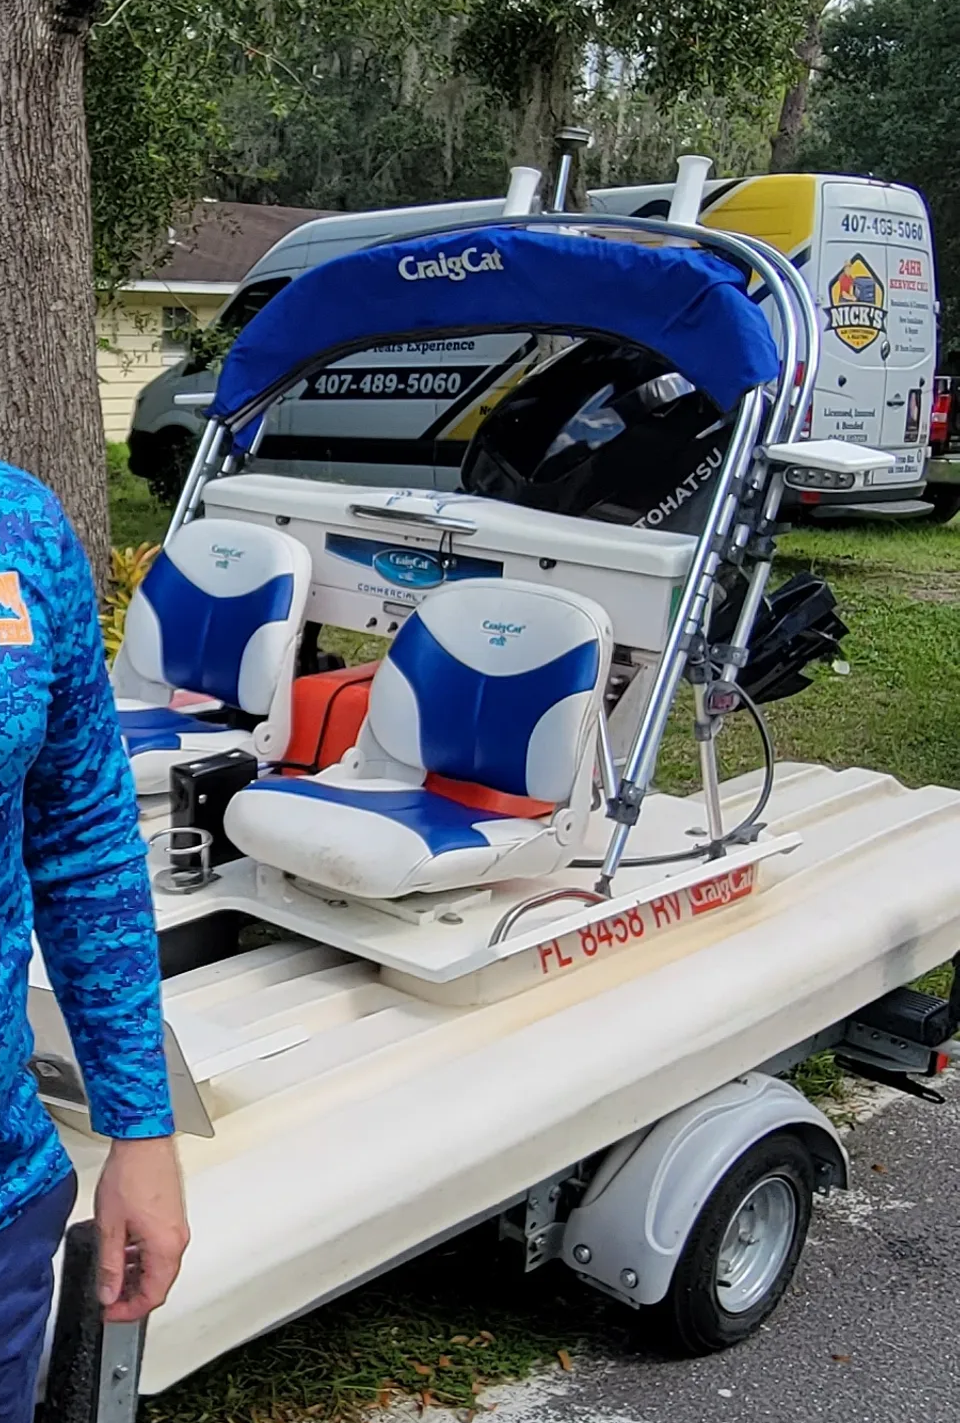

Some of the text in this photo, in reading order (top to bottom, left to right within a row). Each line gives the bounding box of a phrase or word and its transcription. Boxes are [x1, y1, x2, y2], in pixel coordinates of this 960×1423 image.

[841, 213, 923, 241] 407-489-5060
[398, 247, 504, 281] CraigCat
[899, 258, 922, 277] 24HR
[889, 278, 916, 291] SERVICE
[830, 306, 883, 330] NICK'S
[406, 340, 475, 355] Experience
[315, 372, 462, 394] 407-489-5060
[631, 446, 723, 529] TOHATSU
[390, 552, 429, 570] CraigCat
[357, 582, 418, 602] COMMERCIAL
[537, 937, 573, 974] FL
[650, 891, 681, 928] RV
